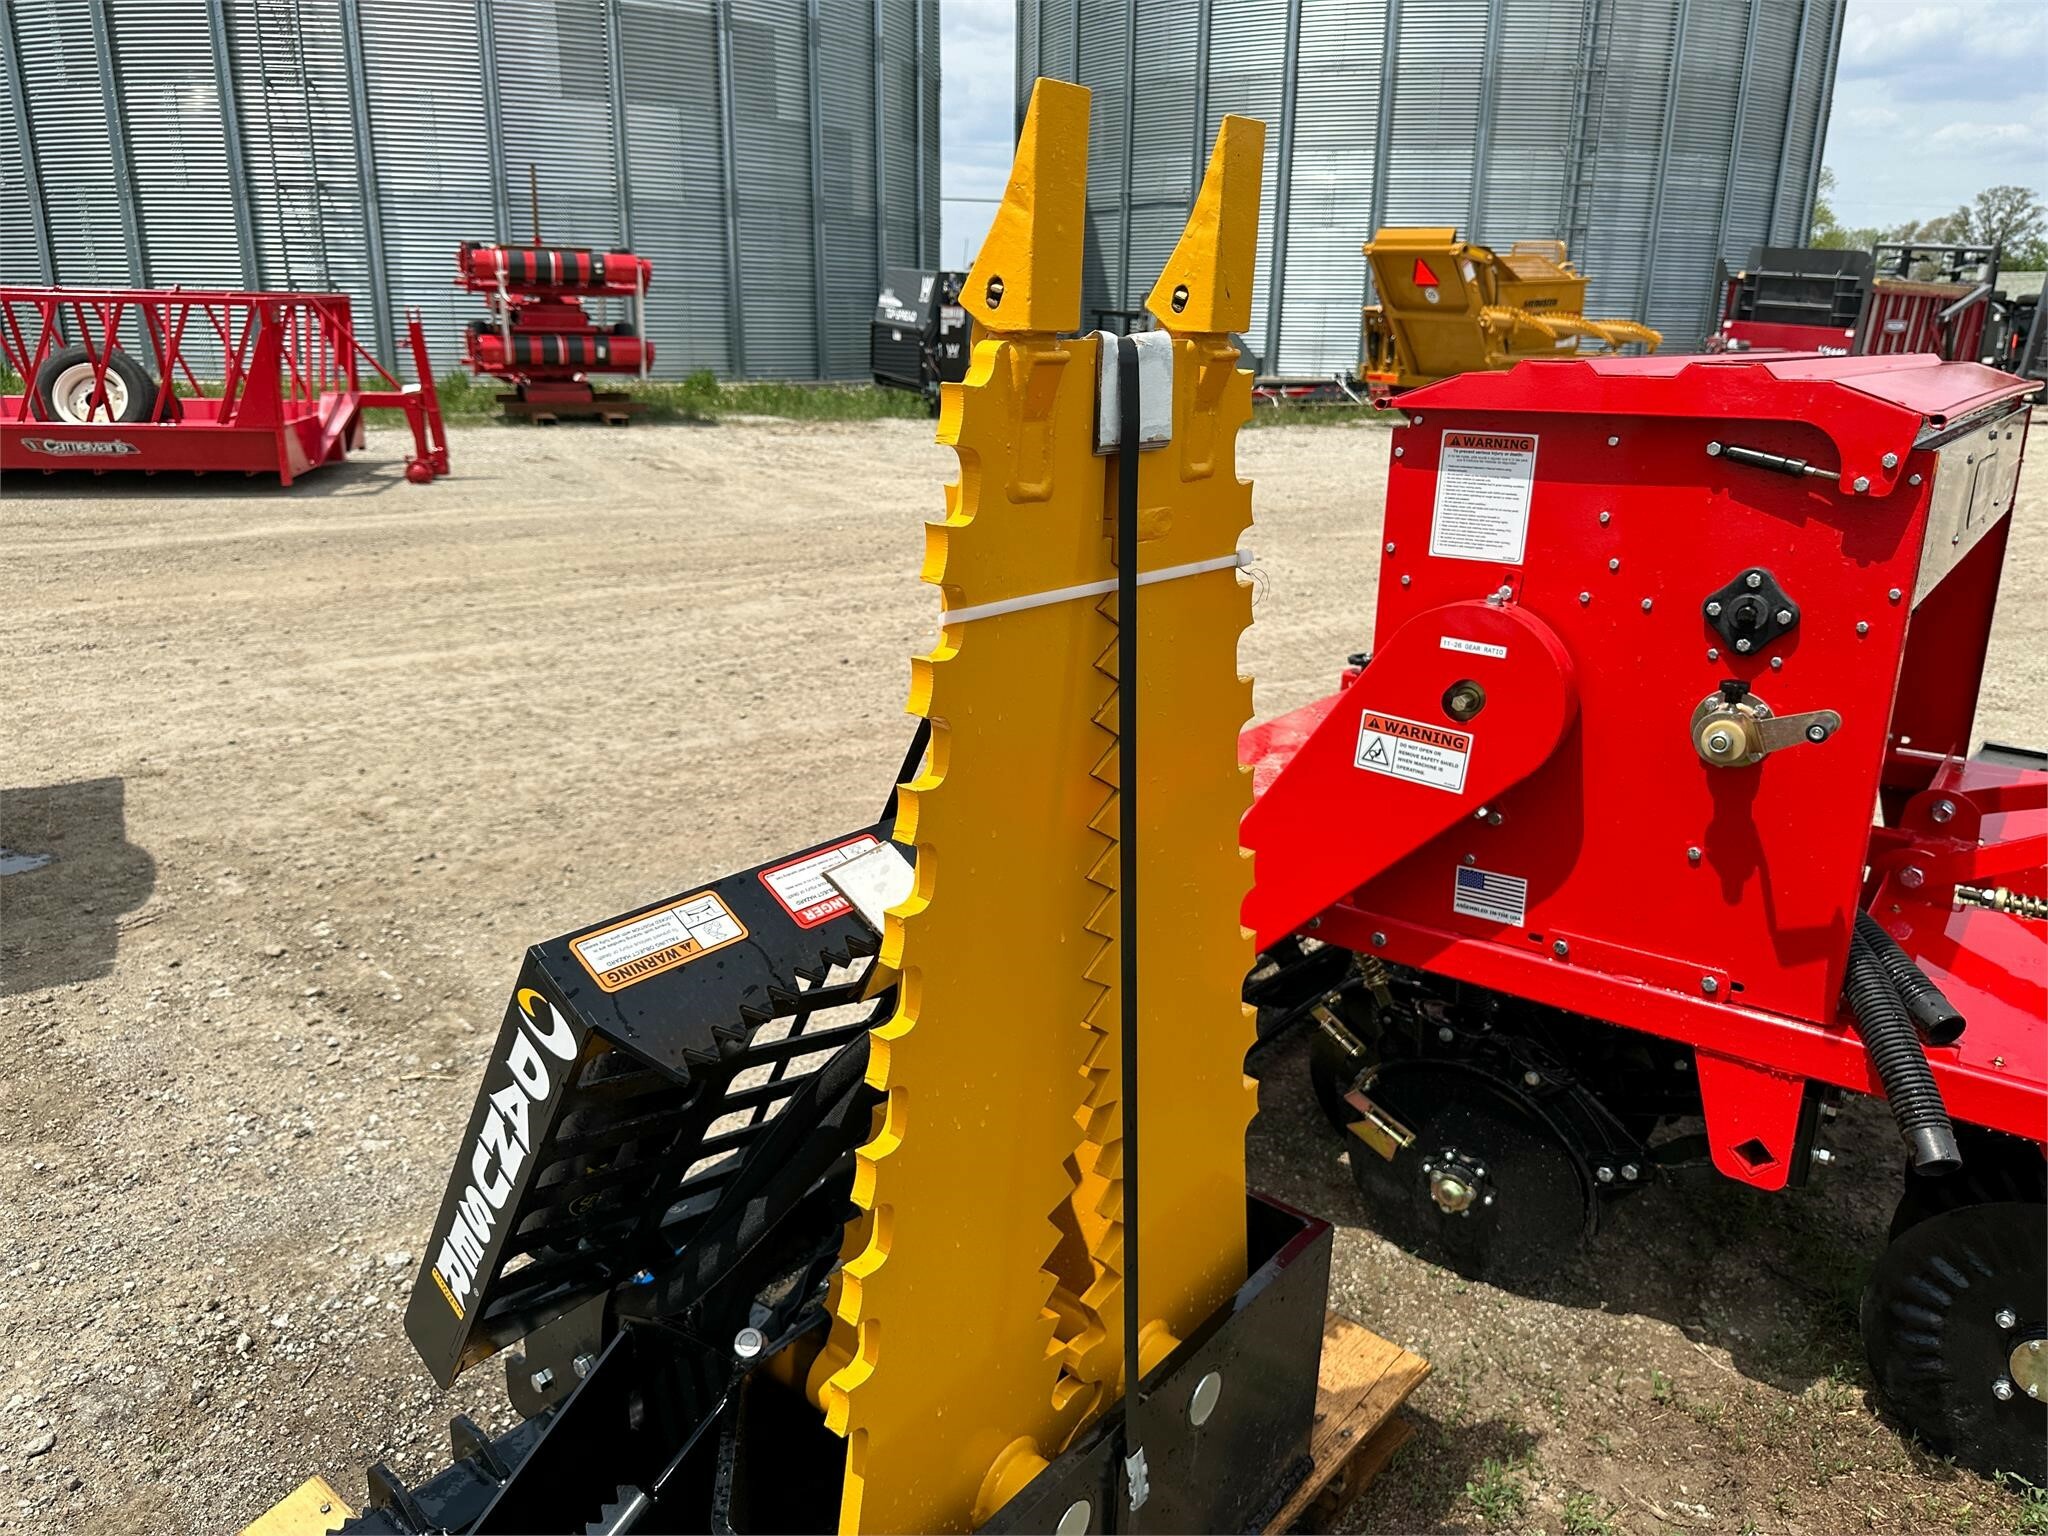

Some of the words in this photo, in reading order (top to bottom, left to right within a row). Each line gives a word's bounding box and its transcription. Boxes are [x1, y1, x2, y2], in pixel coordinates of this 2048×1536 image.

[1463, 436, 1529, 449] WARNING
[1443, 639, 1462, 648] 11-26
[1464, 643, 1480, 651] GEAR
[1483, 646, 1503, 655] RATIO
[1383, 720, 1464, 749] WARNING
[1397, 756, 1412, 764] WHEN
[1413, 760, 1436, 770] MACHINE
[1398, 749, 1419, 758] REMOVE
[1420, 755, 1439, 763] SAFETY
[1440, 760, 1458, 768] SHIELD
[801, 895, 849, 920] NGER
[1455, 902, 1487, 913] ASSEMBLED
[654, 935, 679, 947] FALLING
[631, 944, 655, 956] OBJECT
[605, 953, 631, 966] HAZARD
[605, 947, 681, 983] WARNING
[435, 1027, 551, 1311] DANUSER
